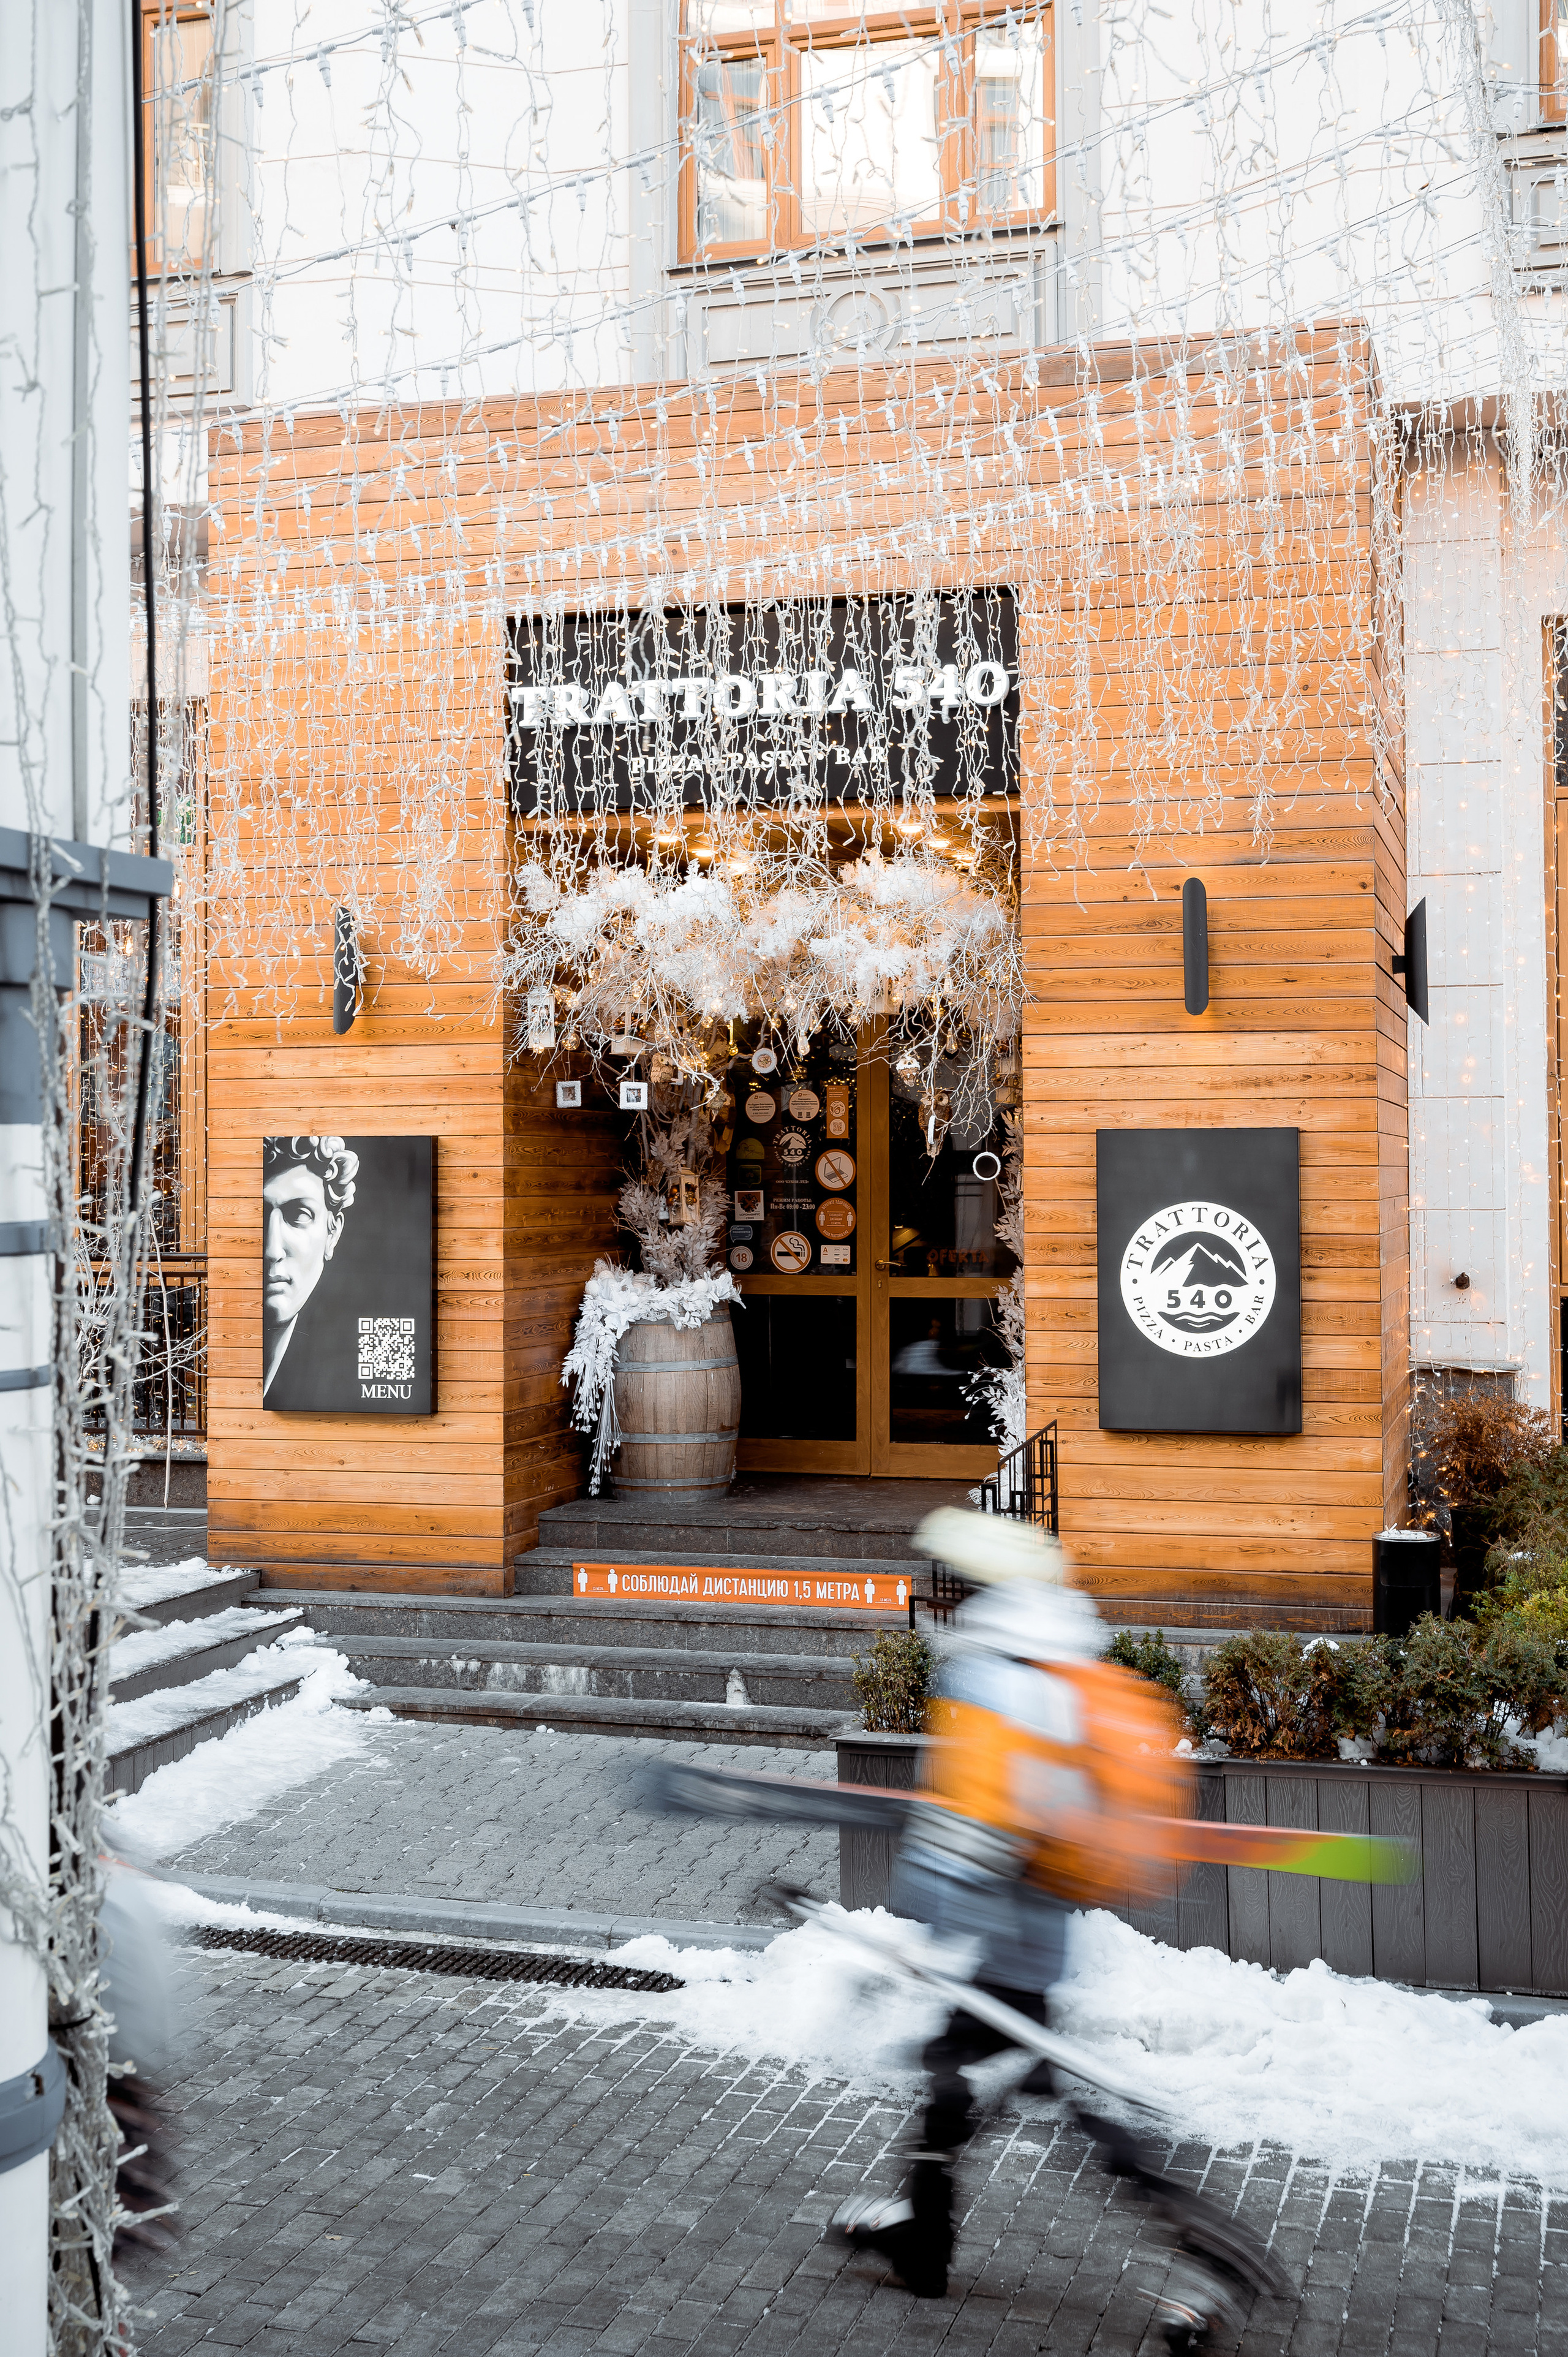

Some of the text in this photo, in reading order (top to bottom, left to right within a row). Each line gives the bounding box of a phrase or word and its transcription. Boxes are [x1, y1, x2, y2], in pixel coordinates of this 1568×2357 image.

[511, 661, 1010, 729] TRATTORIA 540
[631, 746, 886, 774] PIZZA PASTA BAR
[773, 1126, 812, 1144] TRATTORIA
[774, 1151, 783, 1163] PIZZA
[1126, 1207, 1269, 1270] TRATTORIA
[736, 1253, 747, 1262] 18
[927, 1249, 990, 1265] OFERTA
[1166, 1290, 1232, 1308] 540
[1133, 1295, 1264, 1352] PIZZA PASTA BAR
[360, 1384, 412, 1399] MENU
[622, 1573, 860, 1601] СОБЛЮДАЙ ДИСТАНЦИЮ 1,5 МЕТРА
